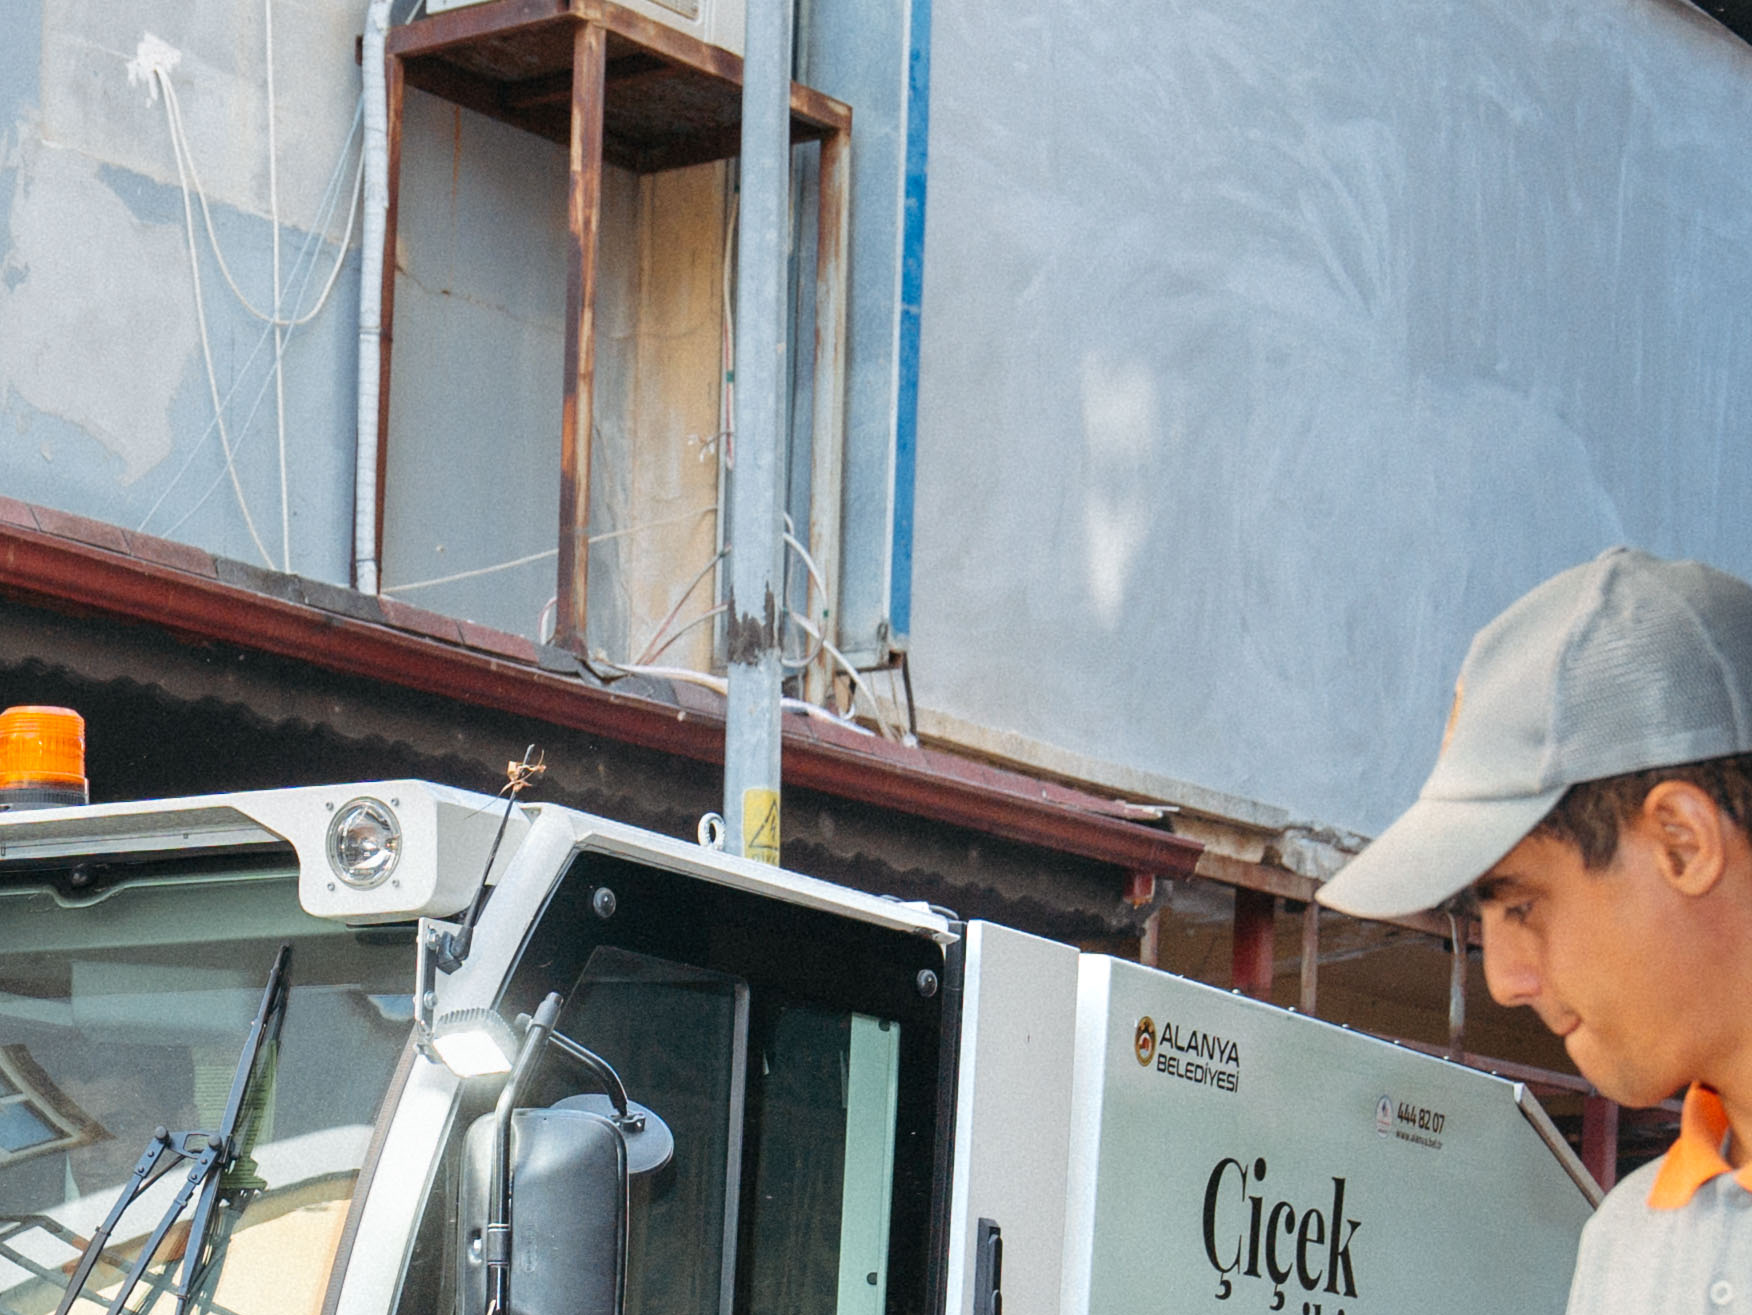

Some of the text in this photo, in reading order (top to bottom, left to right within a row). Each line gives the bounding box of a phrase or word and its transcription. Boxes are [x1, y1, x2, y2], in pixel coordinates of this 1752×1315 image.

[1159, 1021, 1240, 1068] ALANYA
[1157, 1052, 1239, 1093] BELEDİYESİ
[1397, 1101, 1416, 1127] 444
[1418, 1107, 1431, 1131] 82
[1432, 1112, 1445, 1135] 07
[1203, 1157, 1362, 1311] Çiçek
